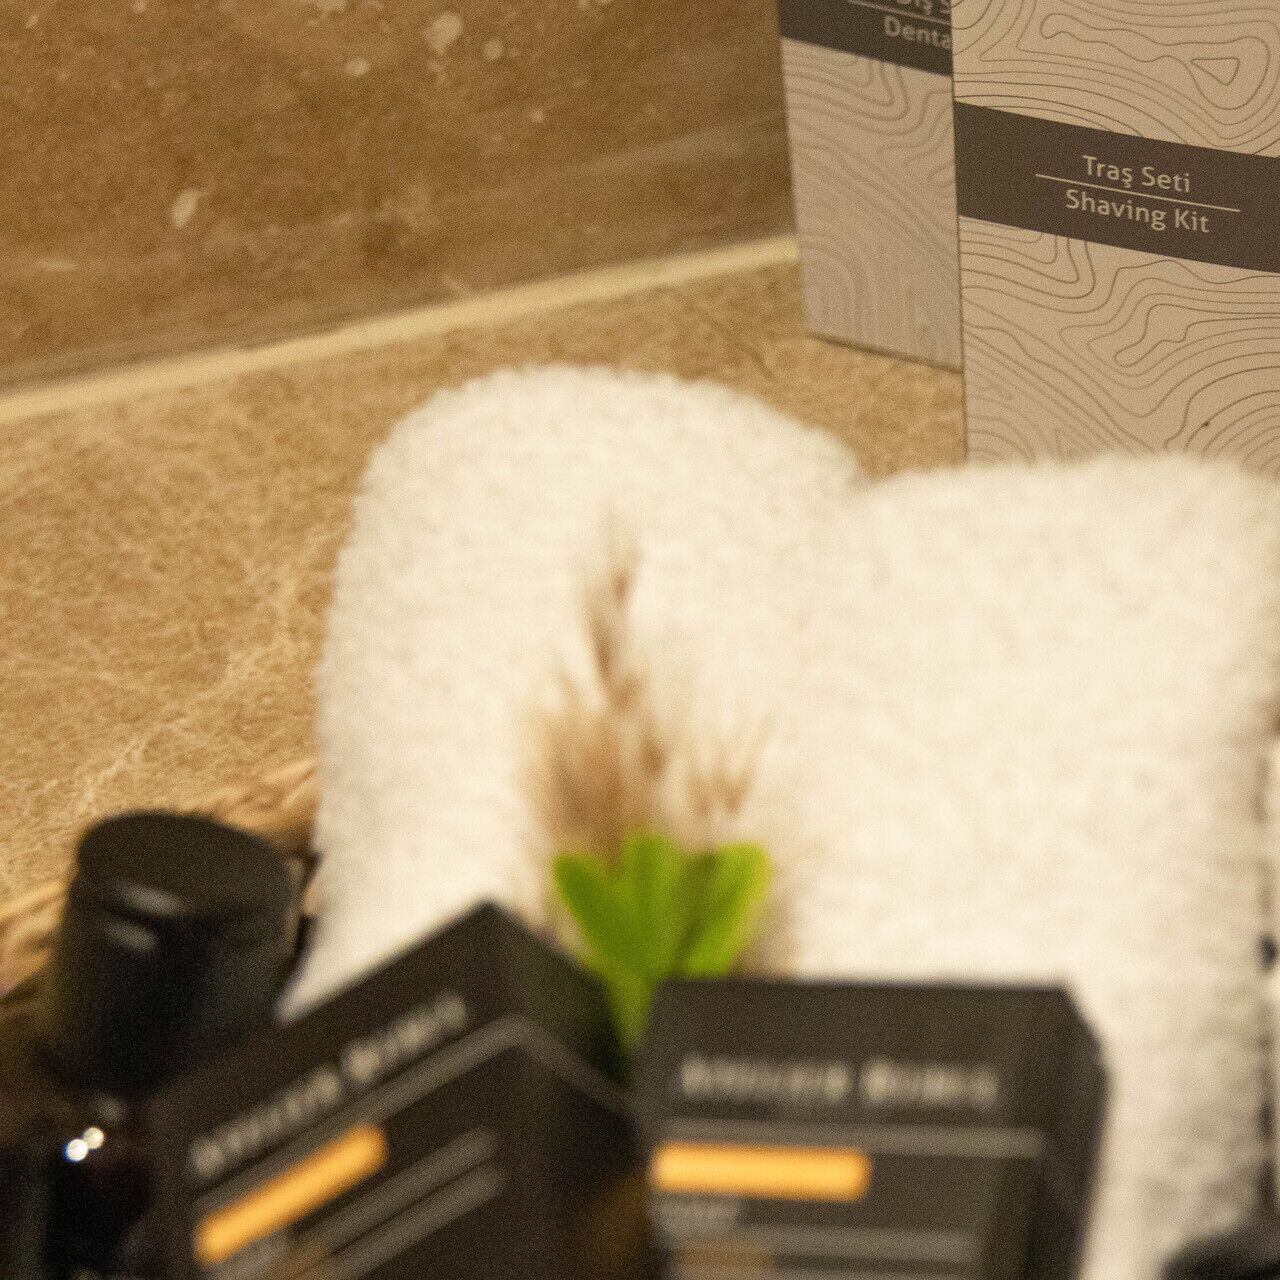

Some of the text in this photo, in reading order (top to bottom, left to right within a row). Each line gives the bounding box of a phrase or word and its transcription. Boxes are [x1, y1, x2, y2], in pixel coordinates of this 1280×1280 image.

[884, 14, 951, 50] Denta
[1082, 154, 1191, 193] Traş Seti
[1065, 189, 1210, 233] Shaving Kit
